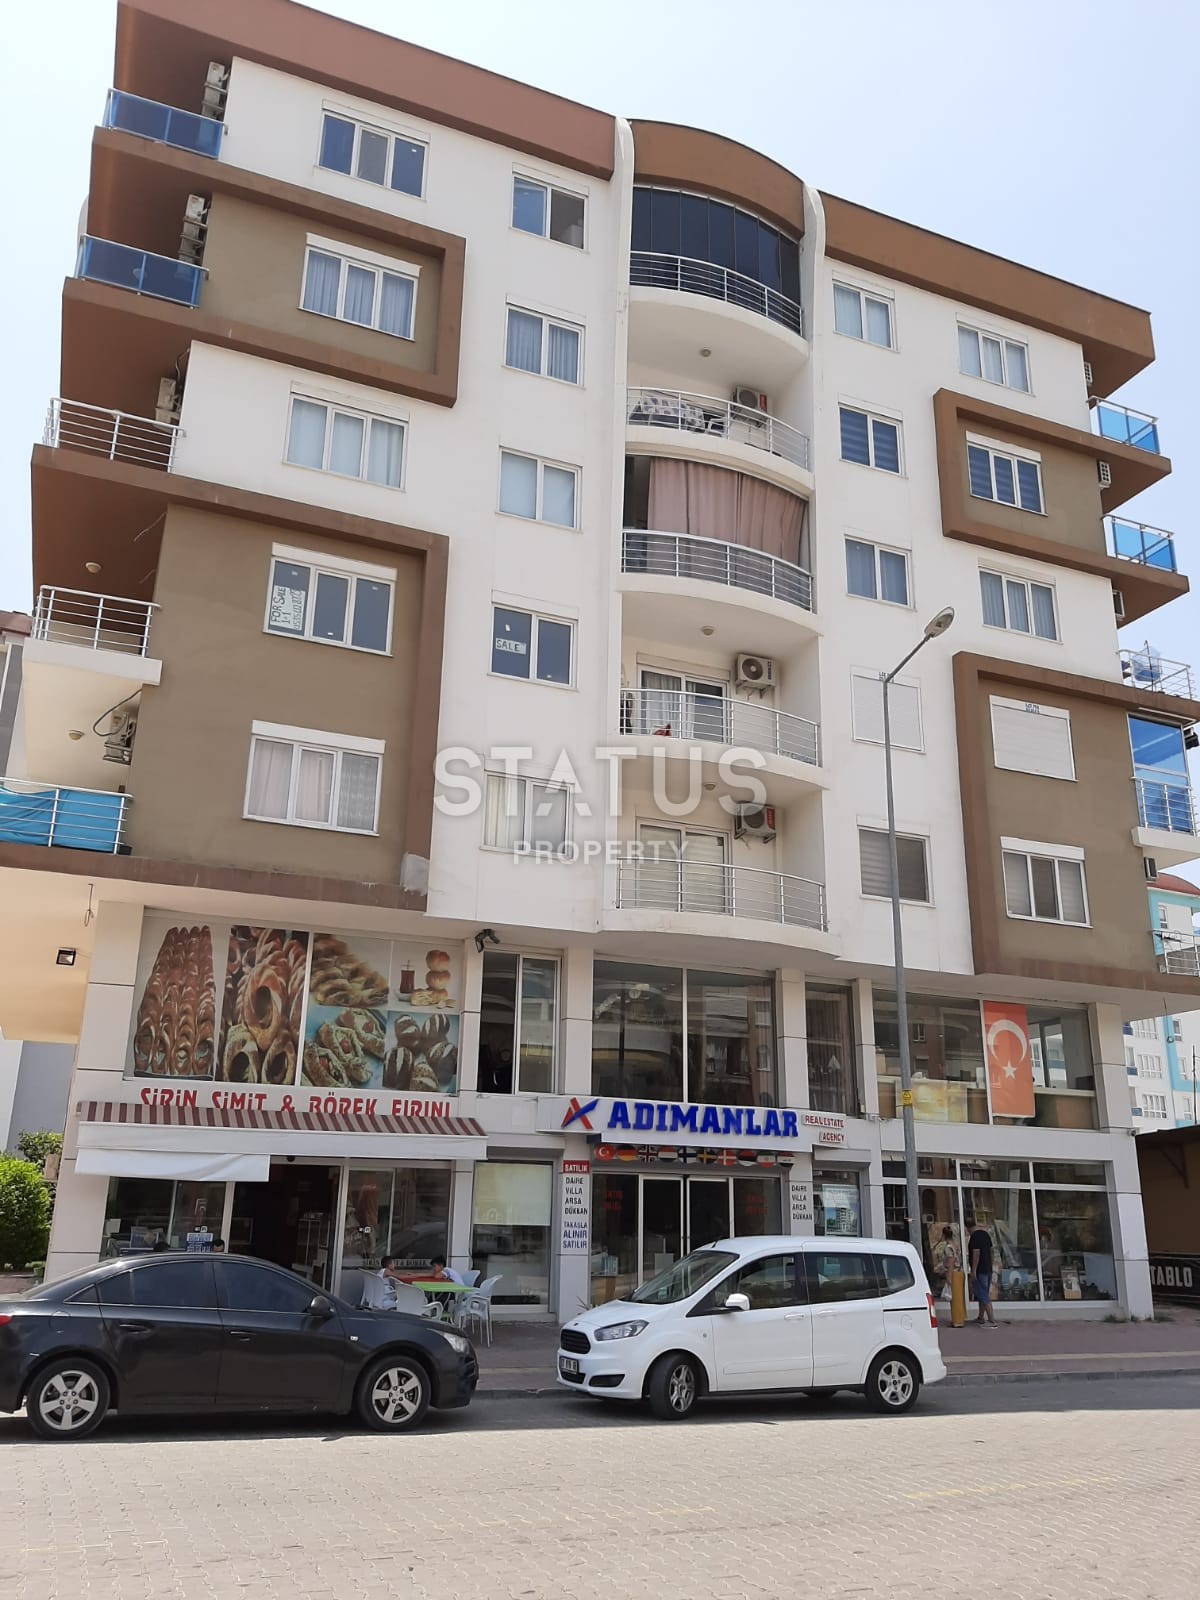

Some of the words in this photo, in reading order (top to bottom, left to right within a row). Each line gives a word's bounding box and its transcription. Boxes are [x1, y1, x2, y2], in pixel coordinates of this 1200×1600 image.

[271, 605, 282, 622] FOR
[496, 639, 521, 652] SALE
[281, 1094, 296, 1113] &
[607, 1101, 798, 1137] ADIMANLAR
[805, 1115, 823, 1125] REAL
[823, 1118, 844, 1128] ESTATE
[823, 1132, 844, 1141] AGENCY
[792, 1202, 807, 1211] ARSA
[563, 1230, 587, 1238] ALINIR
[1150, 1265, 1193, 1288] TABLO
